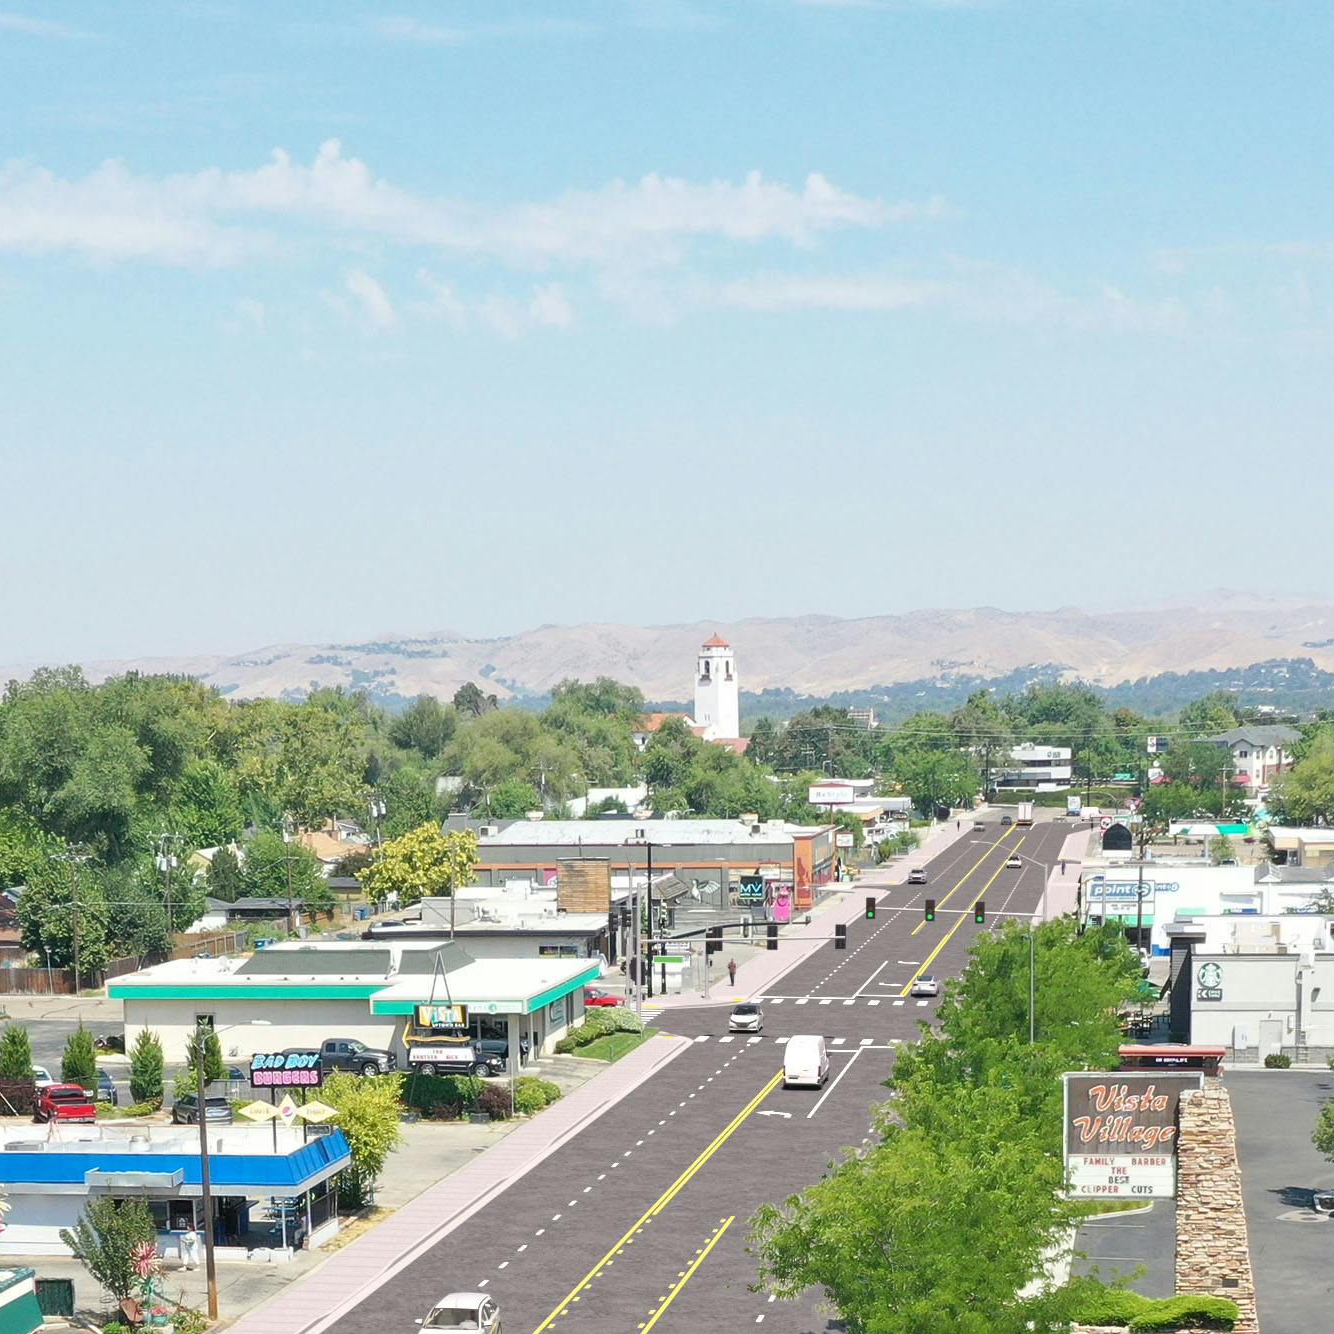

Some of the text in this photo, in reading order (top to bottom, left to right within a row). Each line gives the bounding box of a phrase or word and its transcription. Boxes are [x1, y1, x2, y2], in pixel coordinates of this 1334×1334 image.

[1094, 884, 1130, 895] point
[251, 1053, 319, 1069] BAD BOY
[253, 1071, 318, 1085] BURGERS
[1089, 1084, 1169, 1112] Vista
[1072, 1115, 1177, 1150] Village
[1083, 1157, 1167, 1165] FAMILY BARBER
[1108, 1176, 1130, 1184] BEST
[1081, 1185, 1153, 1194] CLIPPER CUTS
